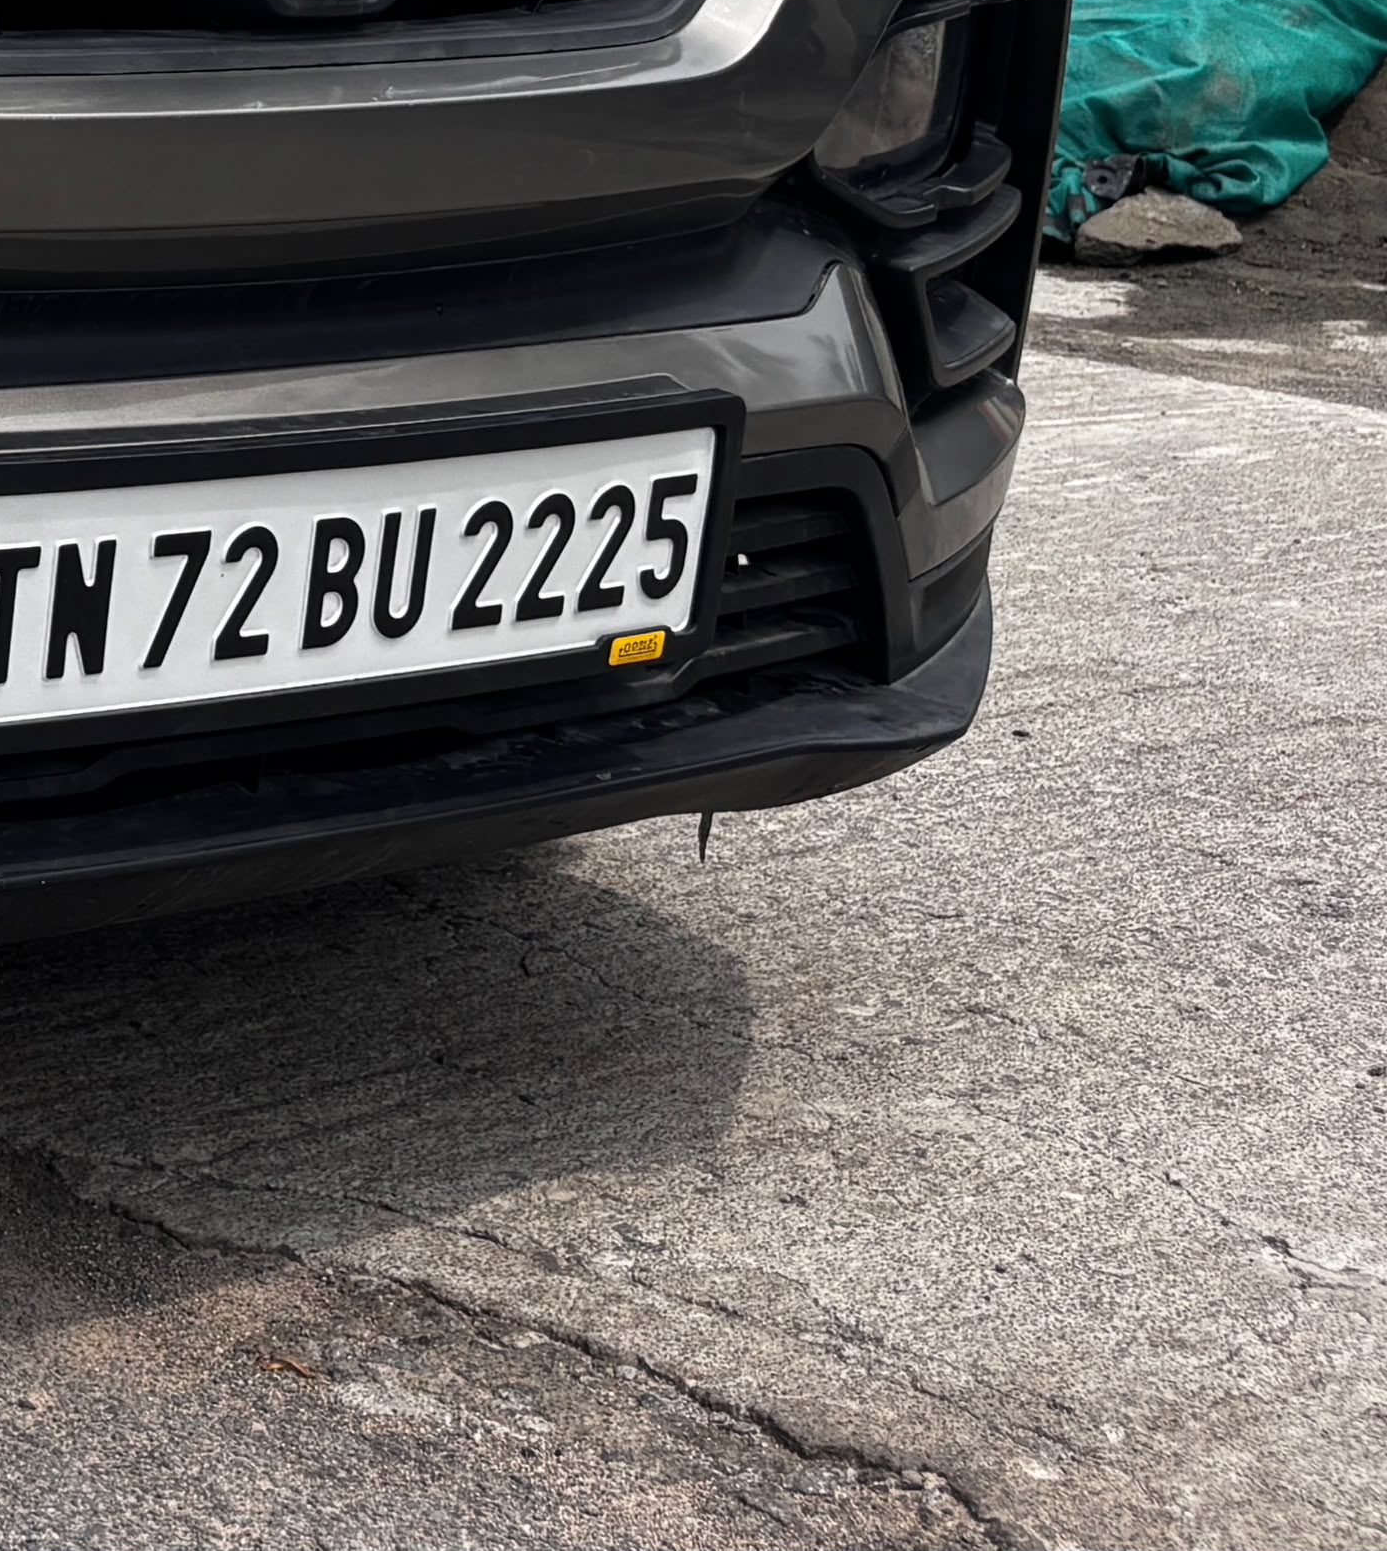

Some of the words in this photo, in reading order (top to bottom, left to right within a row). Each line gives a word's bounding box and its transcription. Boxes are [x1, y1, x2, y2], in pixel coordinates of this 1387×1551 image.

[140, 524, 279, 669] 72
[300, 507, 437, 649] BU
[452, 473, 698, 630] 2225
